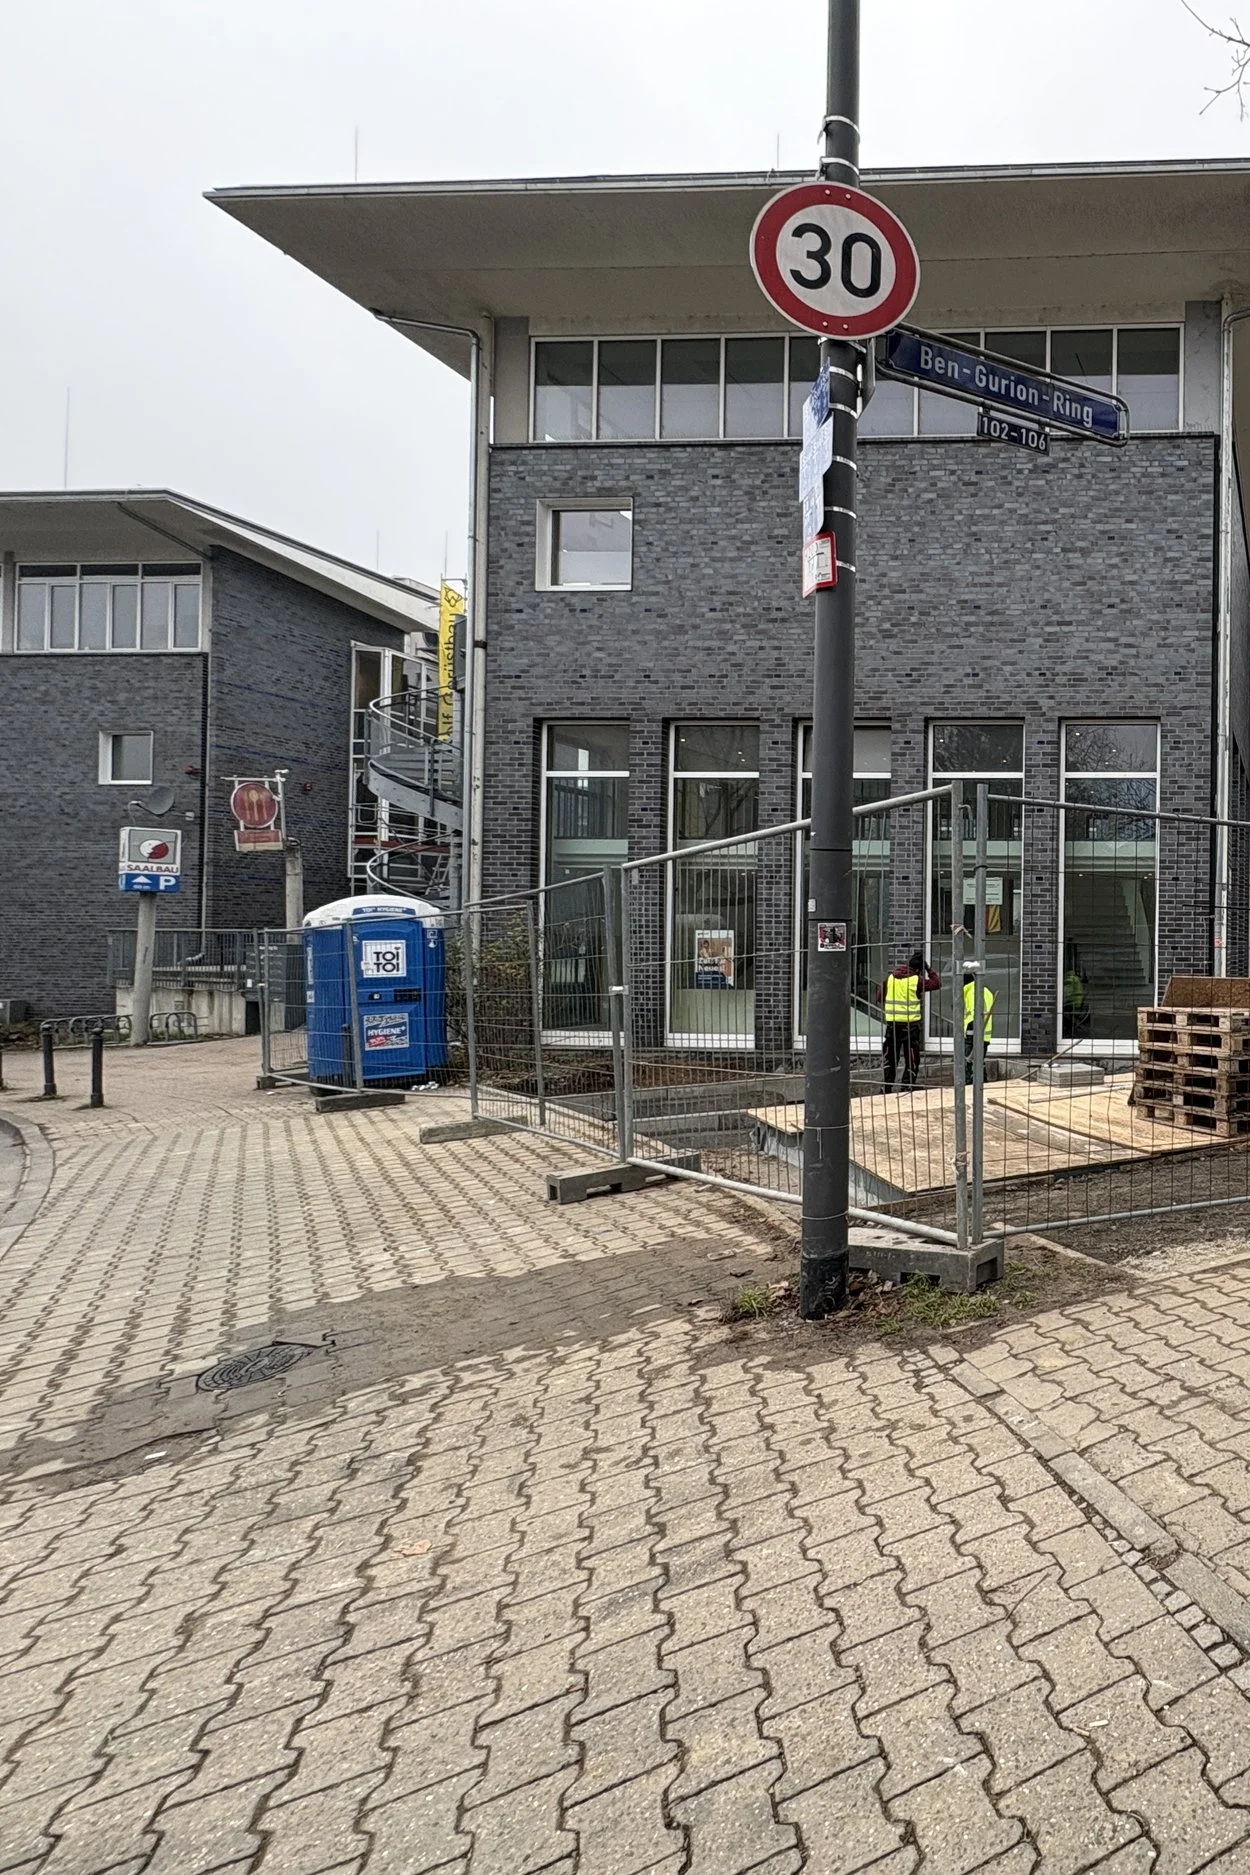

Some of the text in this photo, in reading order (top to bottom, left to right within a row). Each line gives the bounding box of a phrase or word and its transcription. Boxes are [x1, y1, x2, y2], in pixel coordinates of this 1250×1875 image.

[789, 222, 883, 299] 30
[919, 344, 1094, 429] Ben-Gurion-Ring
[981, 416, 1047, 451] 102-106
[126, 864, 179, 874] SAALBAU
[159, 875, 177, 890] P
[373, 950, 400, 962] TOI
[373, 962, 400, 973] TOI
